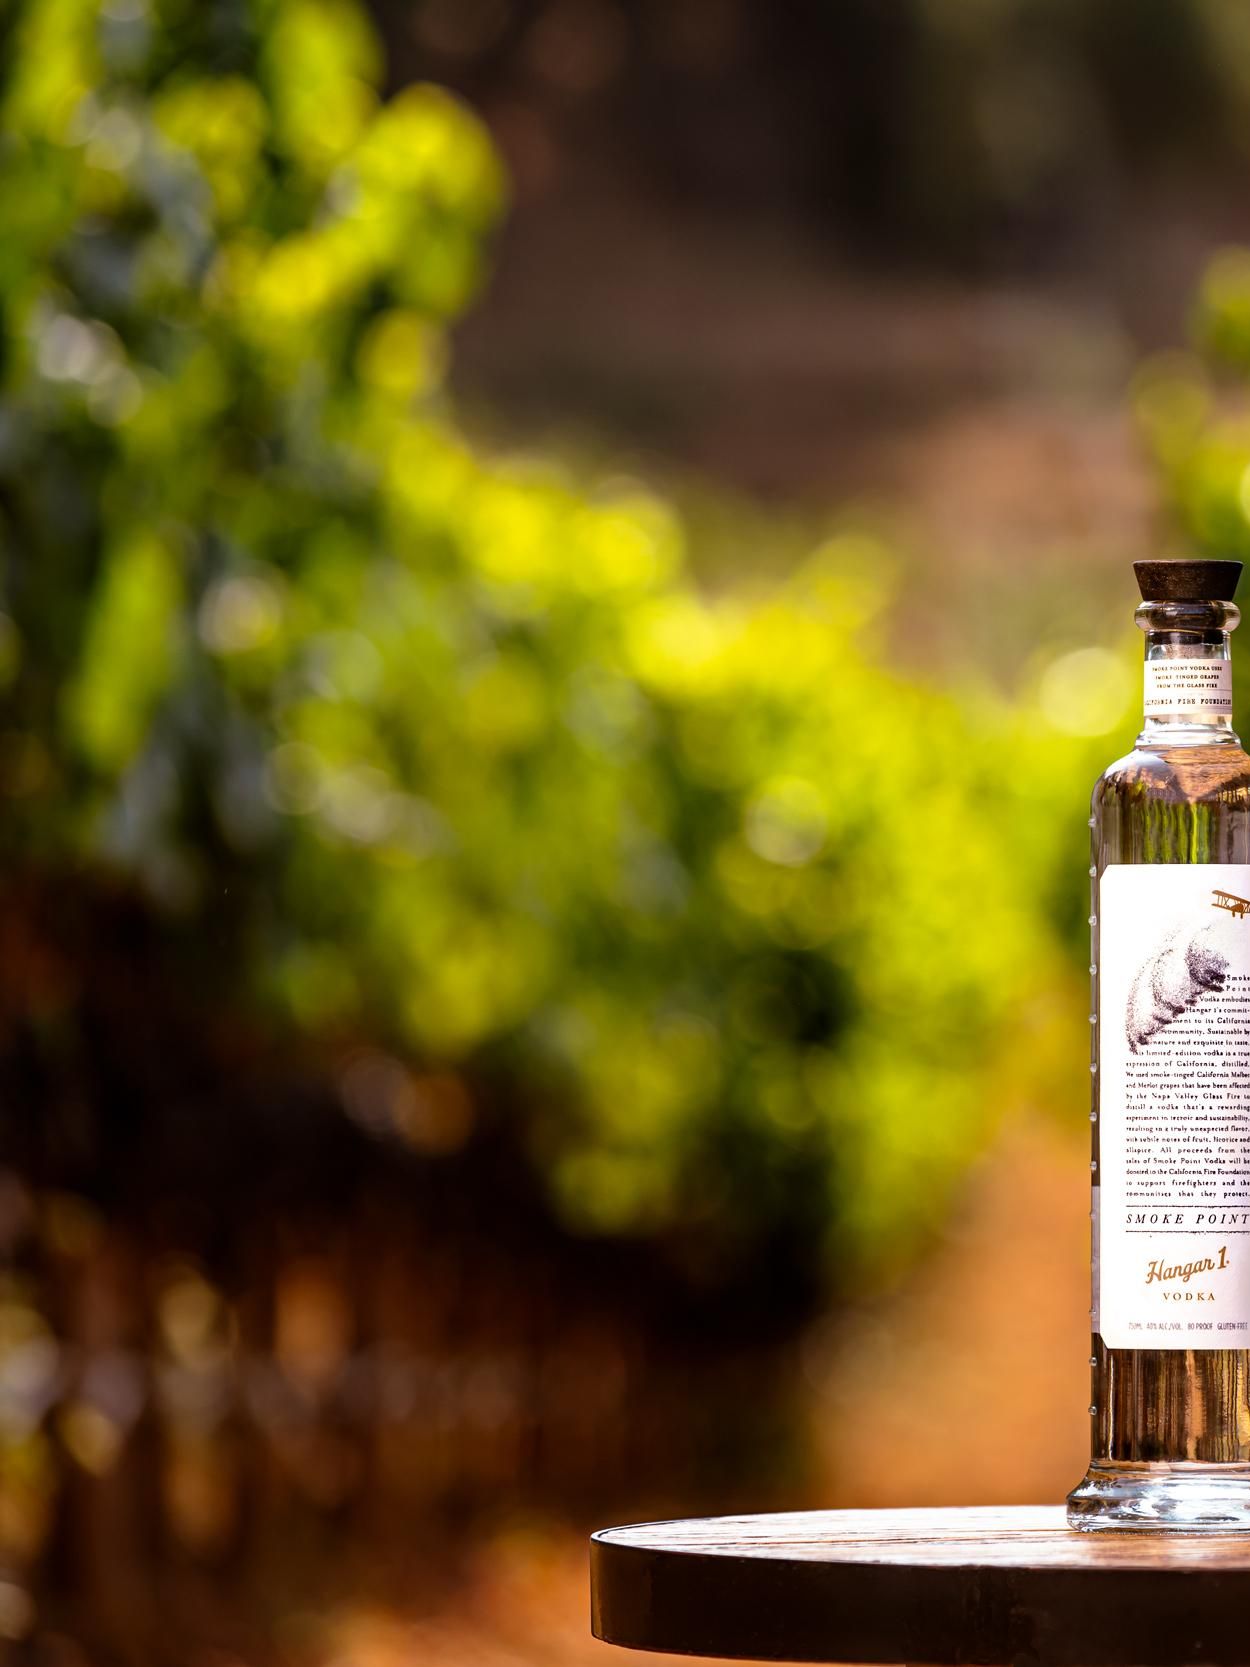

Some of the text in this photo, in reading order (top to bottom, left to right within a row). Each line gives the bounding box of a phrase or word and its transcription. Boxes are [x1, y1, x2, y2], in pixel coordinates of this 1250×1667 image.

[1185, 1006, 1211, 1015] Hangar
[1244, 1027, 1250, 1037] by
[1193, 1038, 1224, 1048] exquisite
[1126, 1092, 1133, 1101] by
[1174, 1092, 1198, 1101] Valley
[1217, 1103, 1250, 1112] rewarding
[1170, 1124, 1187, 1134] truly
[1190, 1124, 1229, 1134] unexpected
[1177, 1146, 1212, 1155] proceeds
[1137, 1179, 1166, 1188] support
[1172, 1178, 1217, 1188] firefighters
[1201, 1190, 1217, 1199] they
[1126, 1214, 1250, 1224] SMOKE POINT
[1145, 1258, 1215, 1284] Hangar
[1163, 1293, 1215, 1301] VODKA
